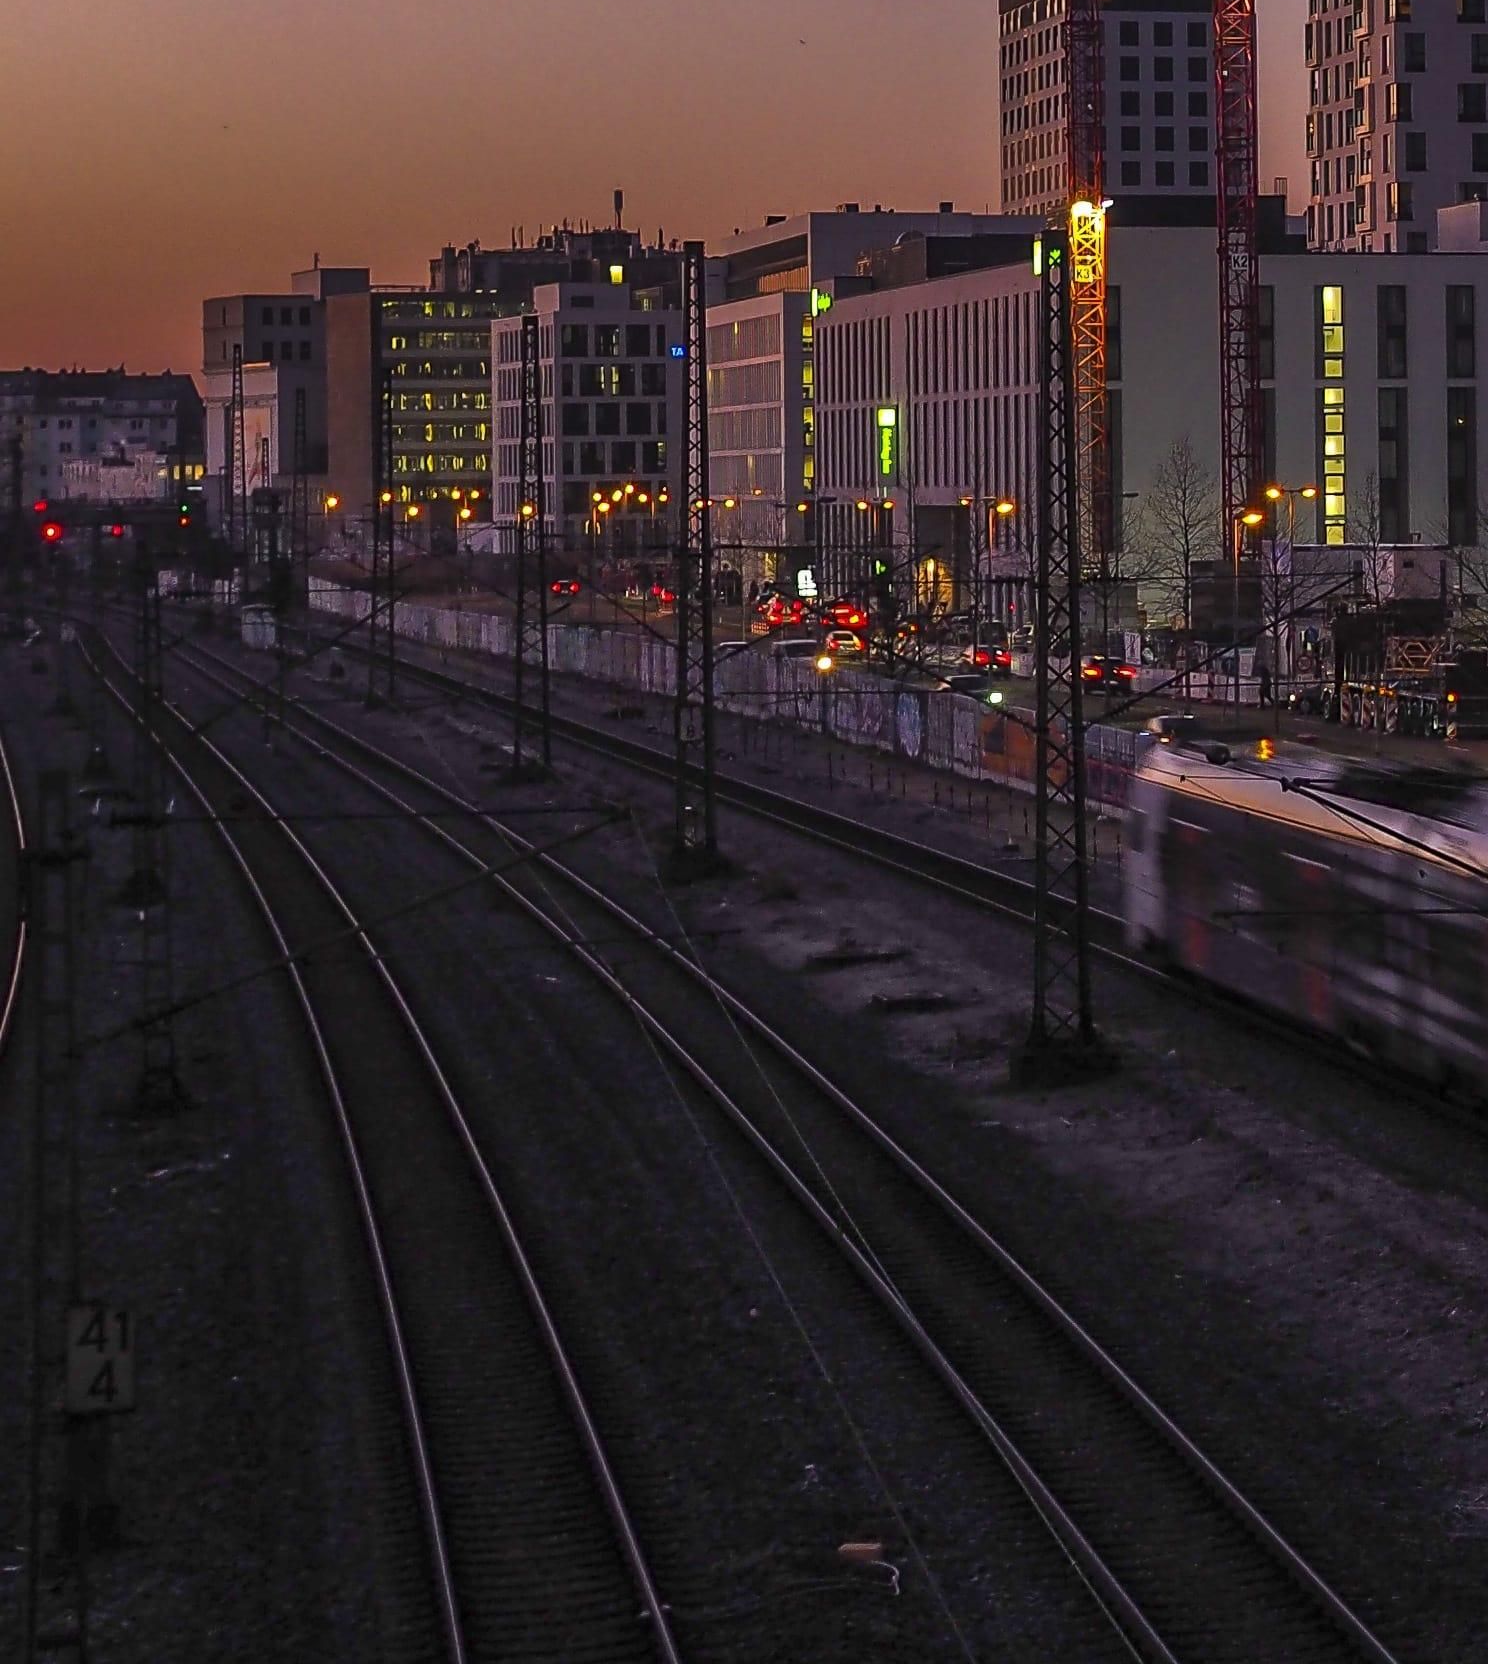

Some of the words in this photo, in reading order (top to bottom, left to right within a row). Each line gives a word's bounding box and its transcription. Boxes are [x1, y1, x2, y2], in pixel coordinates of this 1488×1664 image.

[1232, 255, 1248, 267] K2
[77, 1309, 128, 1352] 41
[87, 1360, 118, 1402] 4
